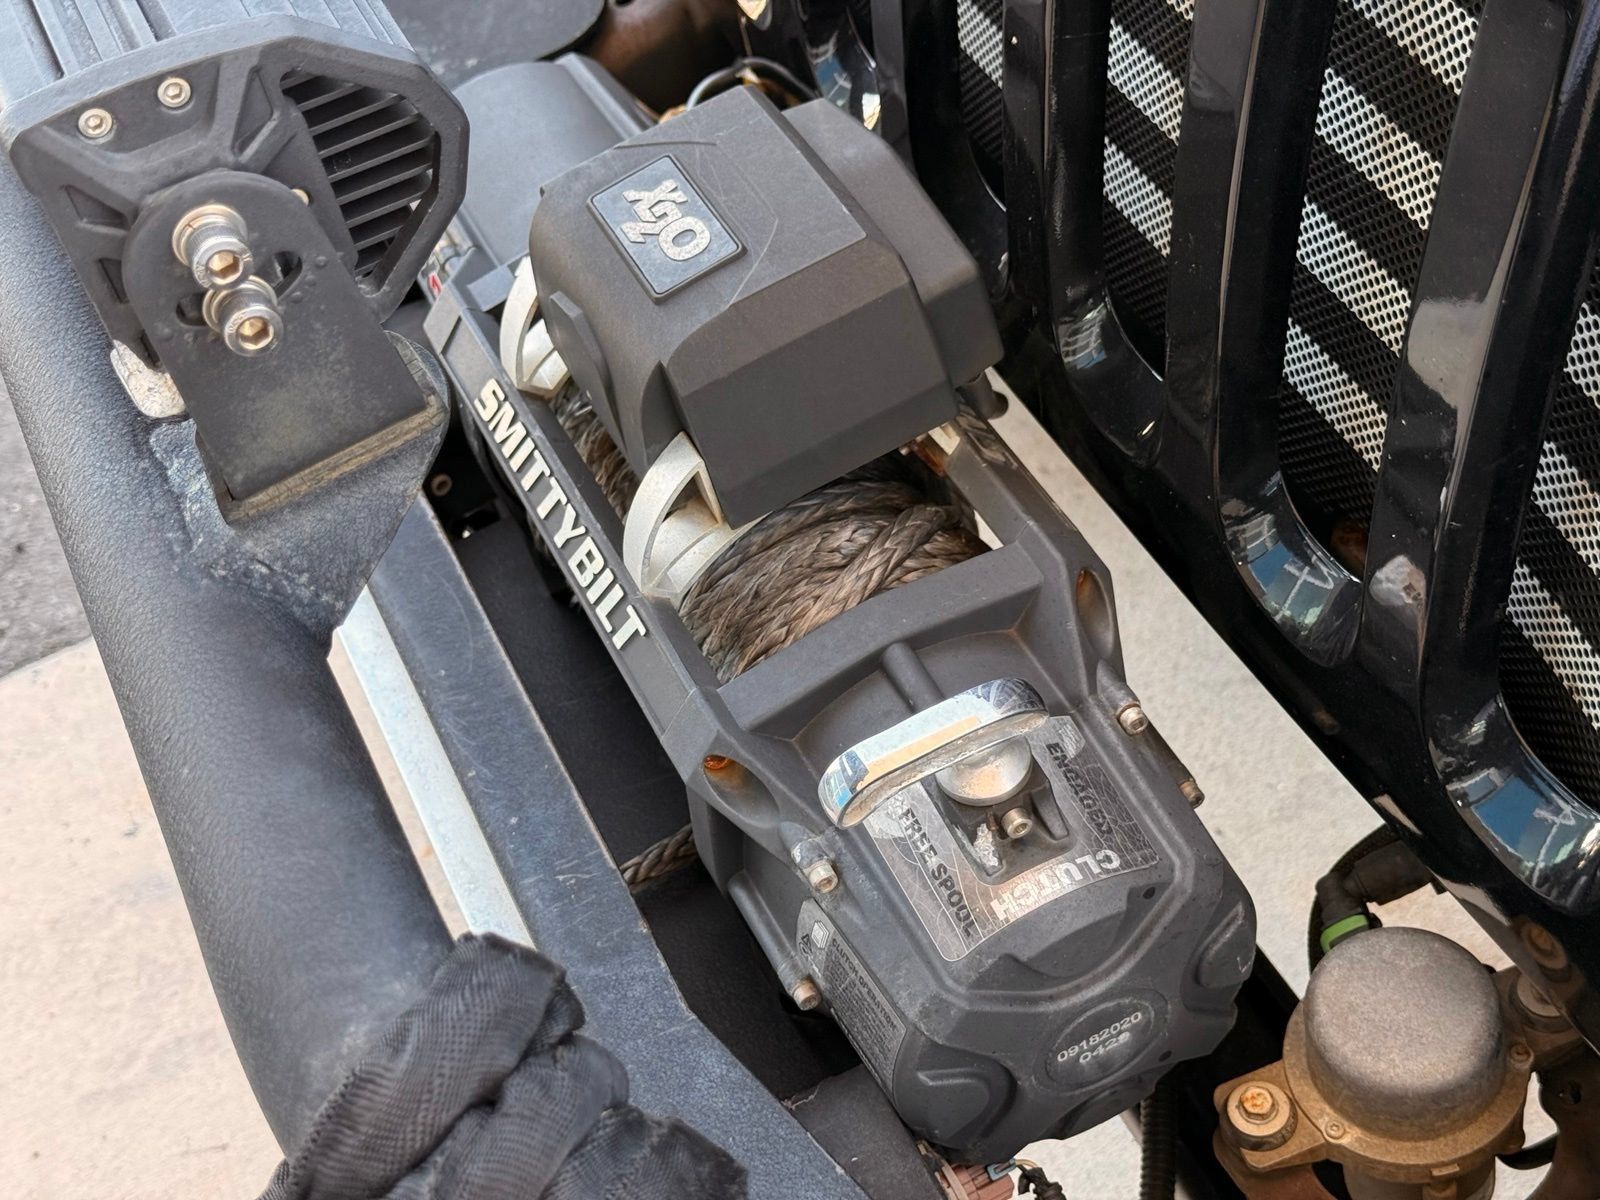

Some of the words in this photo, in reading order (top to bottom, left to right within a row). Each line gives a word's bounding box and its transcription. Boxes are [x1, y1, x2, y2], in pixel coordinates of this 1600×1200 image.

[474, 378, 647, 650] SMITTYBILT
[899, 807, 938, 864] FREE
[930, 863, 977, 938] SPOOL
[990, 849, 1121, 921] CLUTCH
[1057, 1012, 1142, 1062] 09182020
